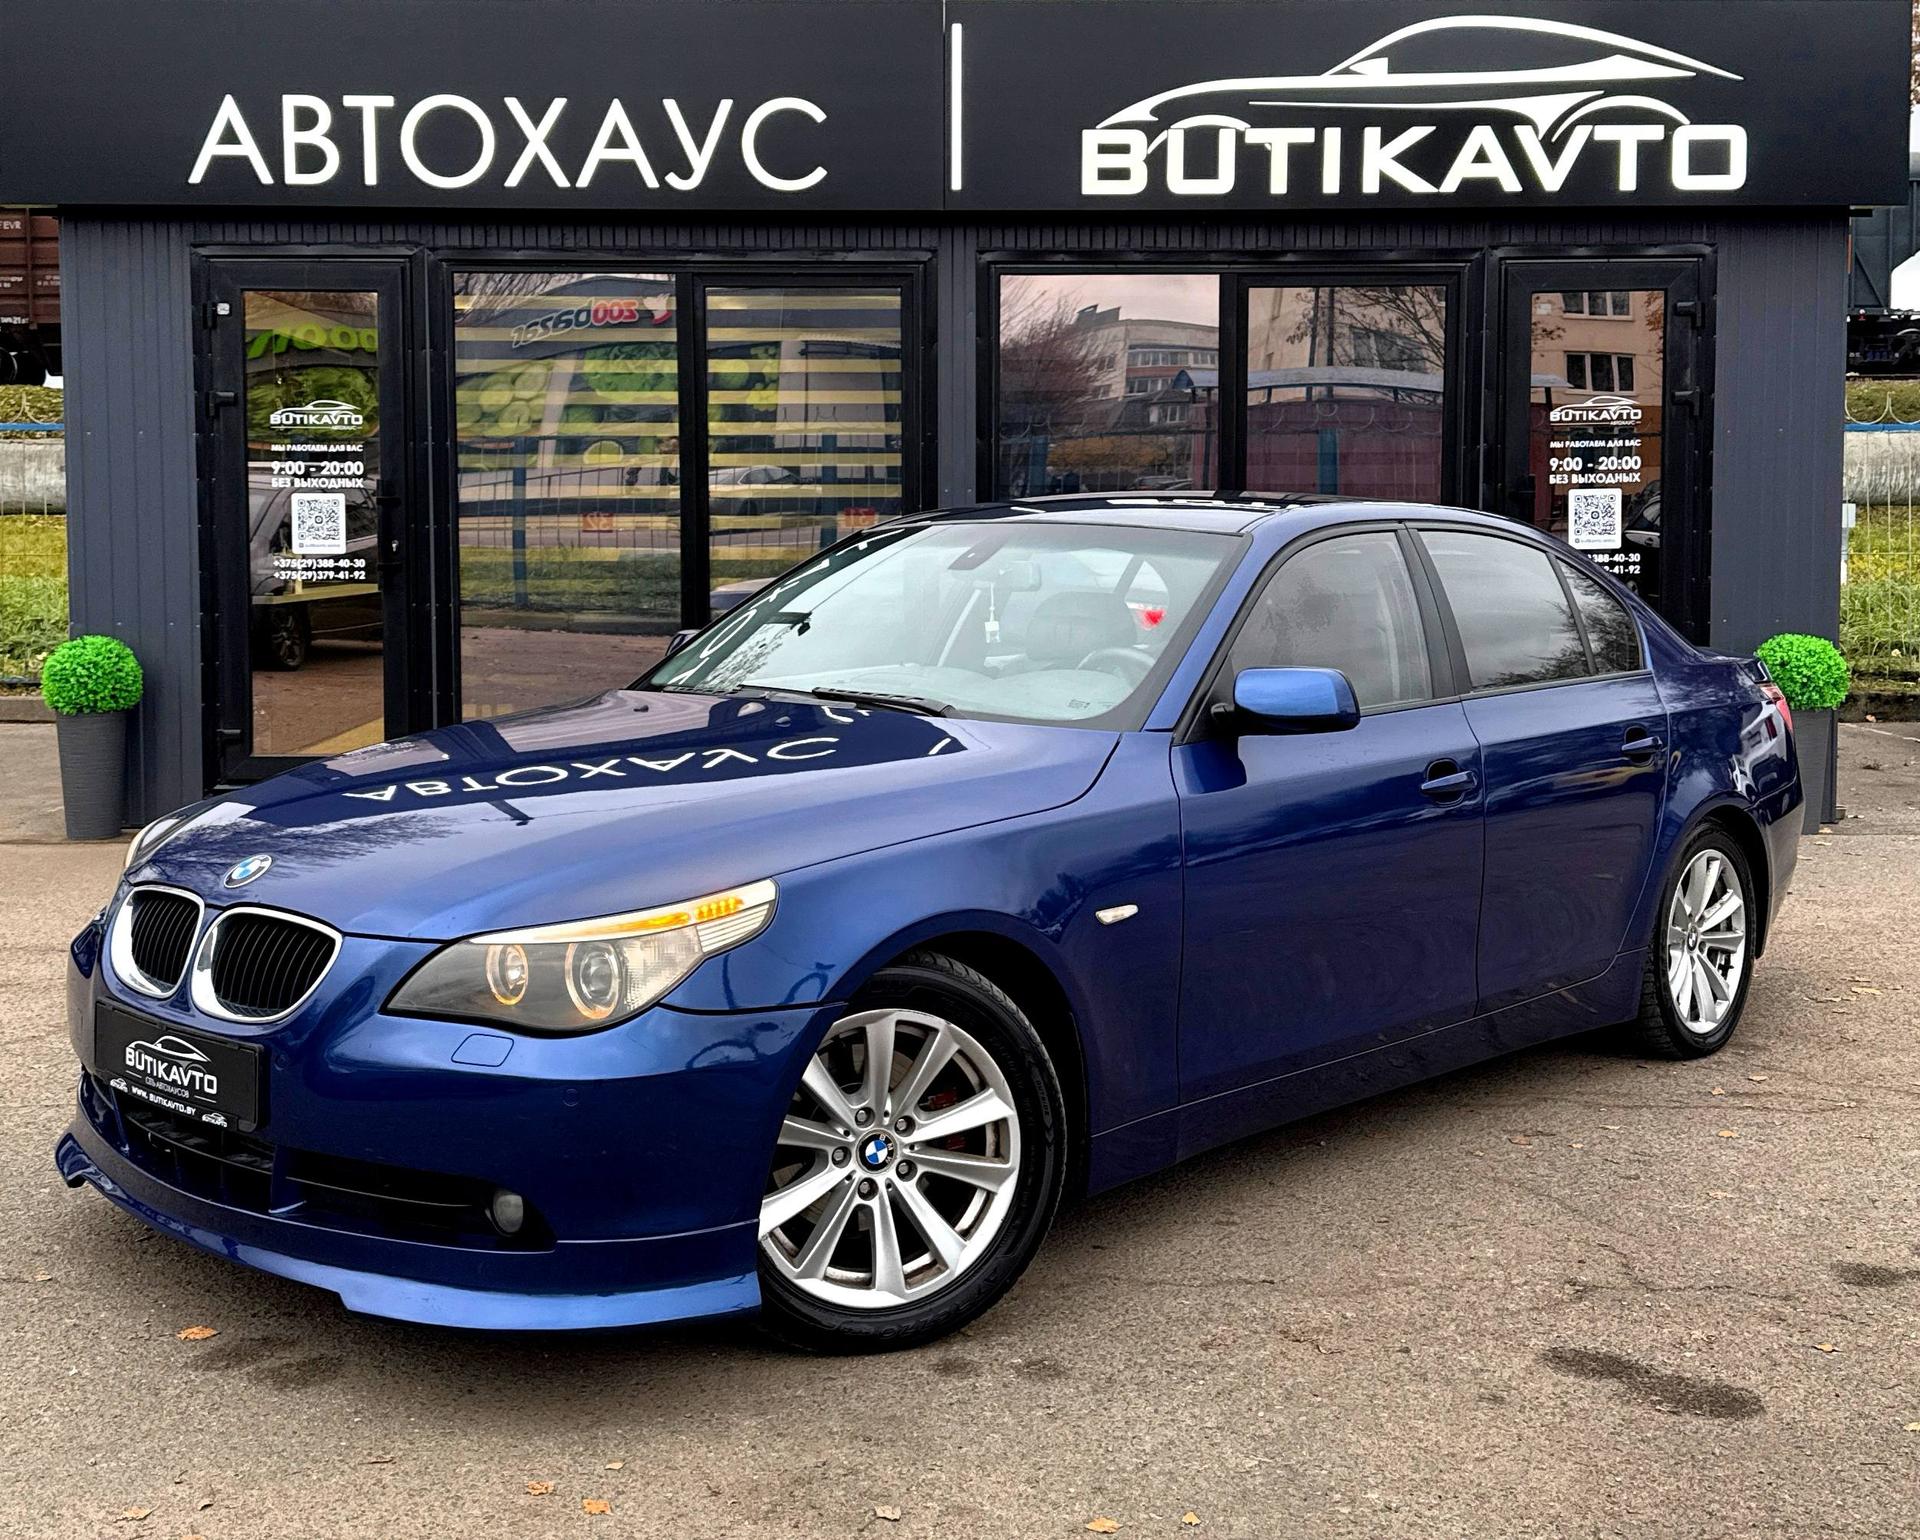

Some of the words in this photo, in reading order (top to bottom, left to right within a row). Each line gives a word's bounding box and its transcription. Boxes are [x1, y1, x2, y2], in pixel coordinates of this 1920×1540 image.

[188, 94, 828, 191] АВТОХАУС
[1081, 124, 1748, 195] BUTIKAVTO
[269, 413, 364, 425] BUTIKAVTO
[1549, 408, 1642, 422] BUTIKAVTO
[271, 444, 285, 452] МЫ
[286, 444, 328, 452] РАБОТАЕМ
[328, 444, 346, 453] ДЛЯ
[346, 444, 364, 452] ВАС
[1549, 440, 1564, 449] МЫ
[1565, 440, 1606, 448] РАБОТАЕМ
[1606, 439, 1624, 448] ДЛЯ
[1624, 438, 1642, 447] ВАС
[271, 460, 306, 475] 9:00
[320, 460, 364, 476] 20:00
[1549, 456, 1583, 472] 9:00
[1598, 455, 1642, 471] 20:00
[271, 477, 291, 488] БЕЗ
[293, 477, 365, 489] ВЫХОДНЫХ
[1549, 473, 1569, 485] БЕЗ
[1571, 472, 1641, 485] ВЫХОДНЫХ
[273, 557, 366, 569] +375(29)388-40-30
[273, 569, 366, 581] +375(29)379-41-92
[125, 1047, 218, 1095] BUTIKAVTO
